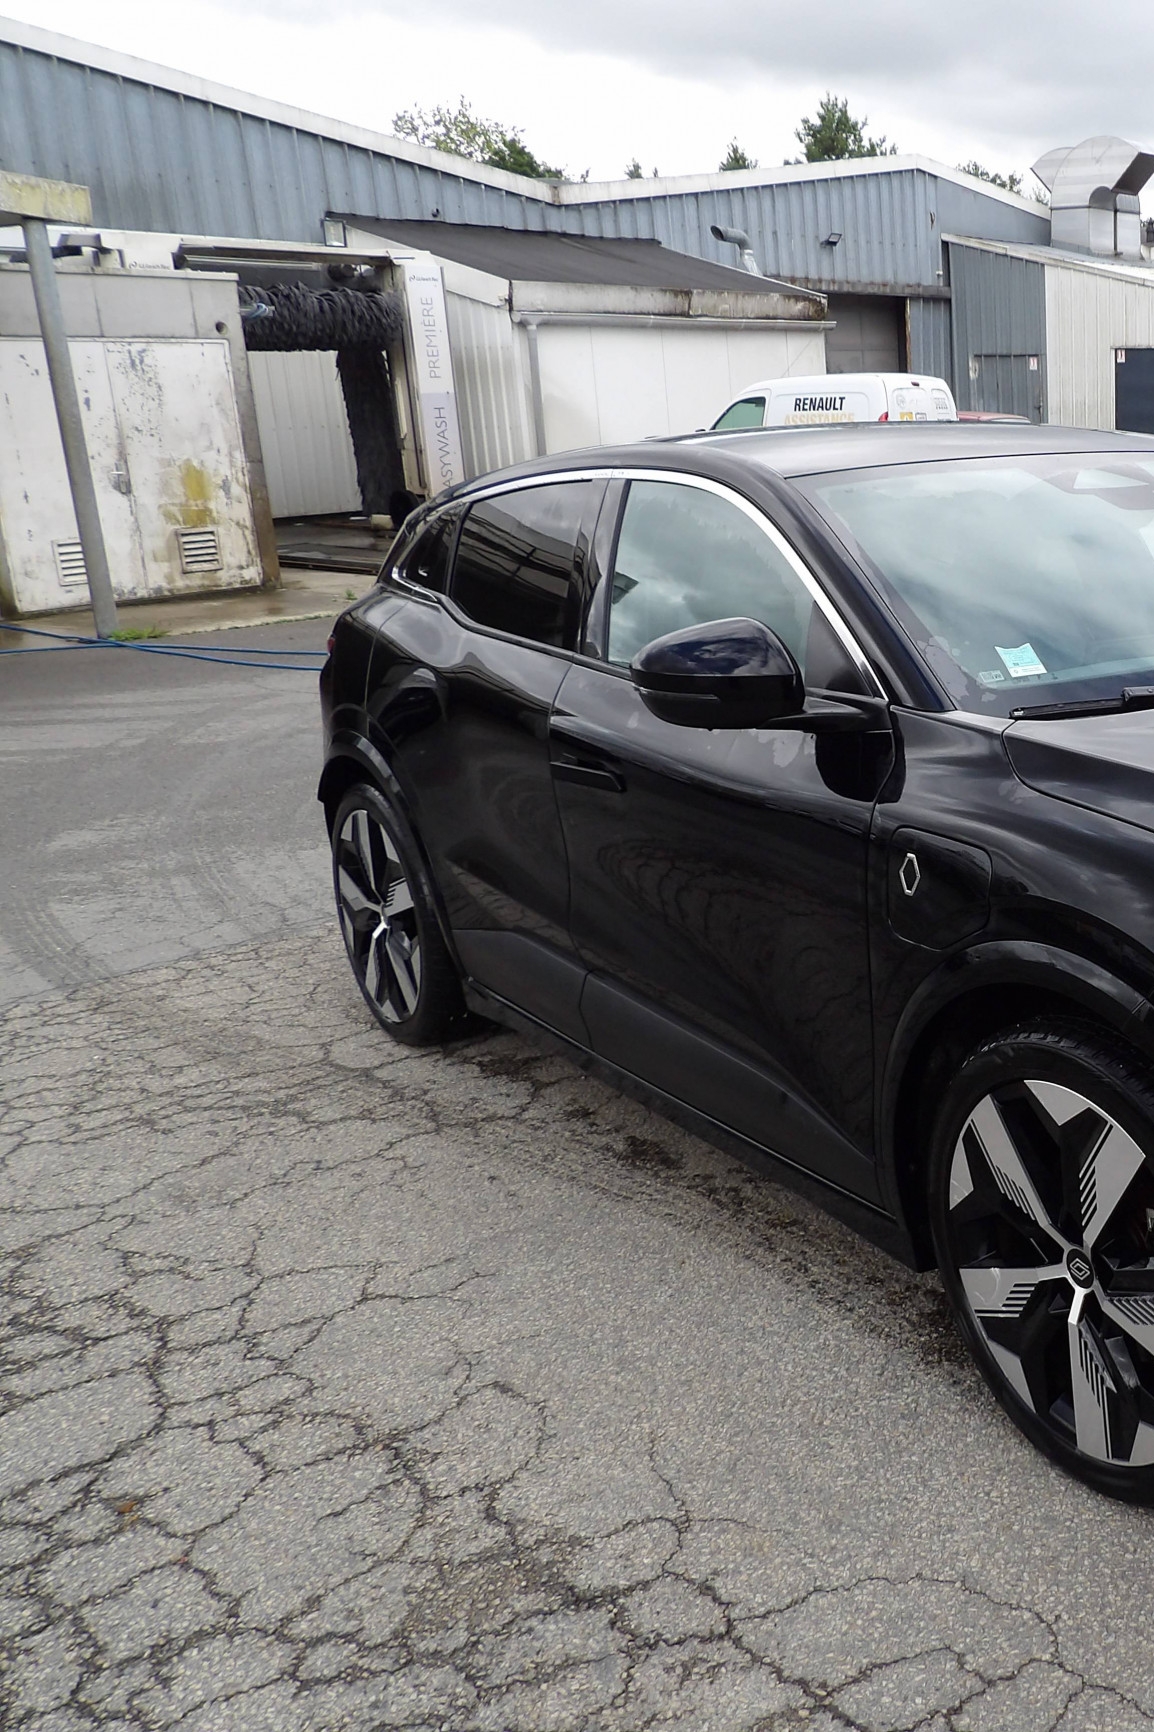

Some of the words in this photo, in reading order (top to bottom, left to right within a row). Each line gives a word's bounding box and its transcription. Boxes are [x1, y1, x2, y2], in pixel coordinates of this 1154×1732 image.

[420, 297, 441, 379] PREMIÈRE
[794, 396, 846, 412] RENAULT
[433, 406, 453, 488] ASYWASH
